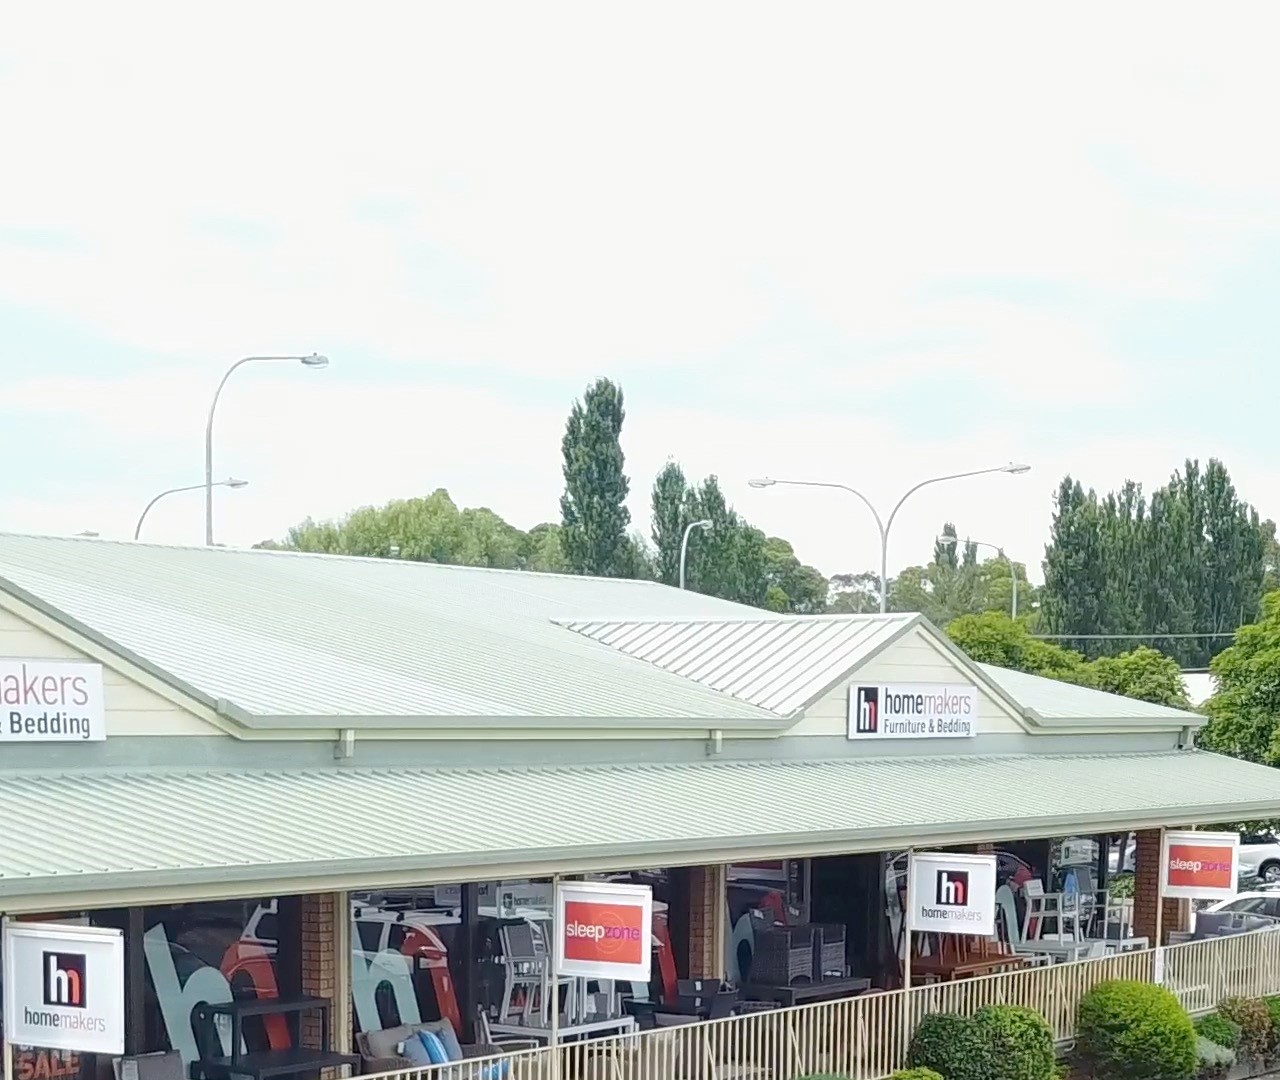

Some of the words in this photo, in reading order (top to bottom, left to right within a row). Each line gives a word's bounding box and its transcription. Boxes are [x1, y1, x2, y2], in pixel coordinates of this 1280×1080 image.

[885, 687, 971, 715] homemakers
[10, 711, 90, 739] Bedding
[884, 719, 926, 734] Furniture
[928, 719, 935, 733] &
[937, 719, 971, 735] Bedding
[1170, 857, 1230, 874] sleepzone
[921, 905, 982, 922] homemakers
[566, 920, 641, 943] sleepzone
[24, 1006, 106, 1033] homemakers
[18, 1050, 80, 1080] SALE
